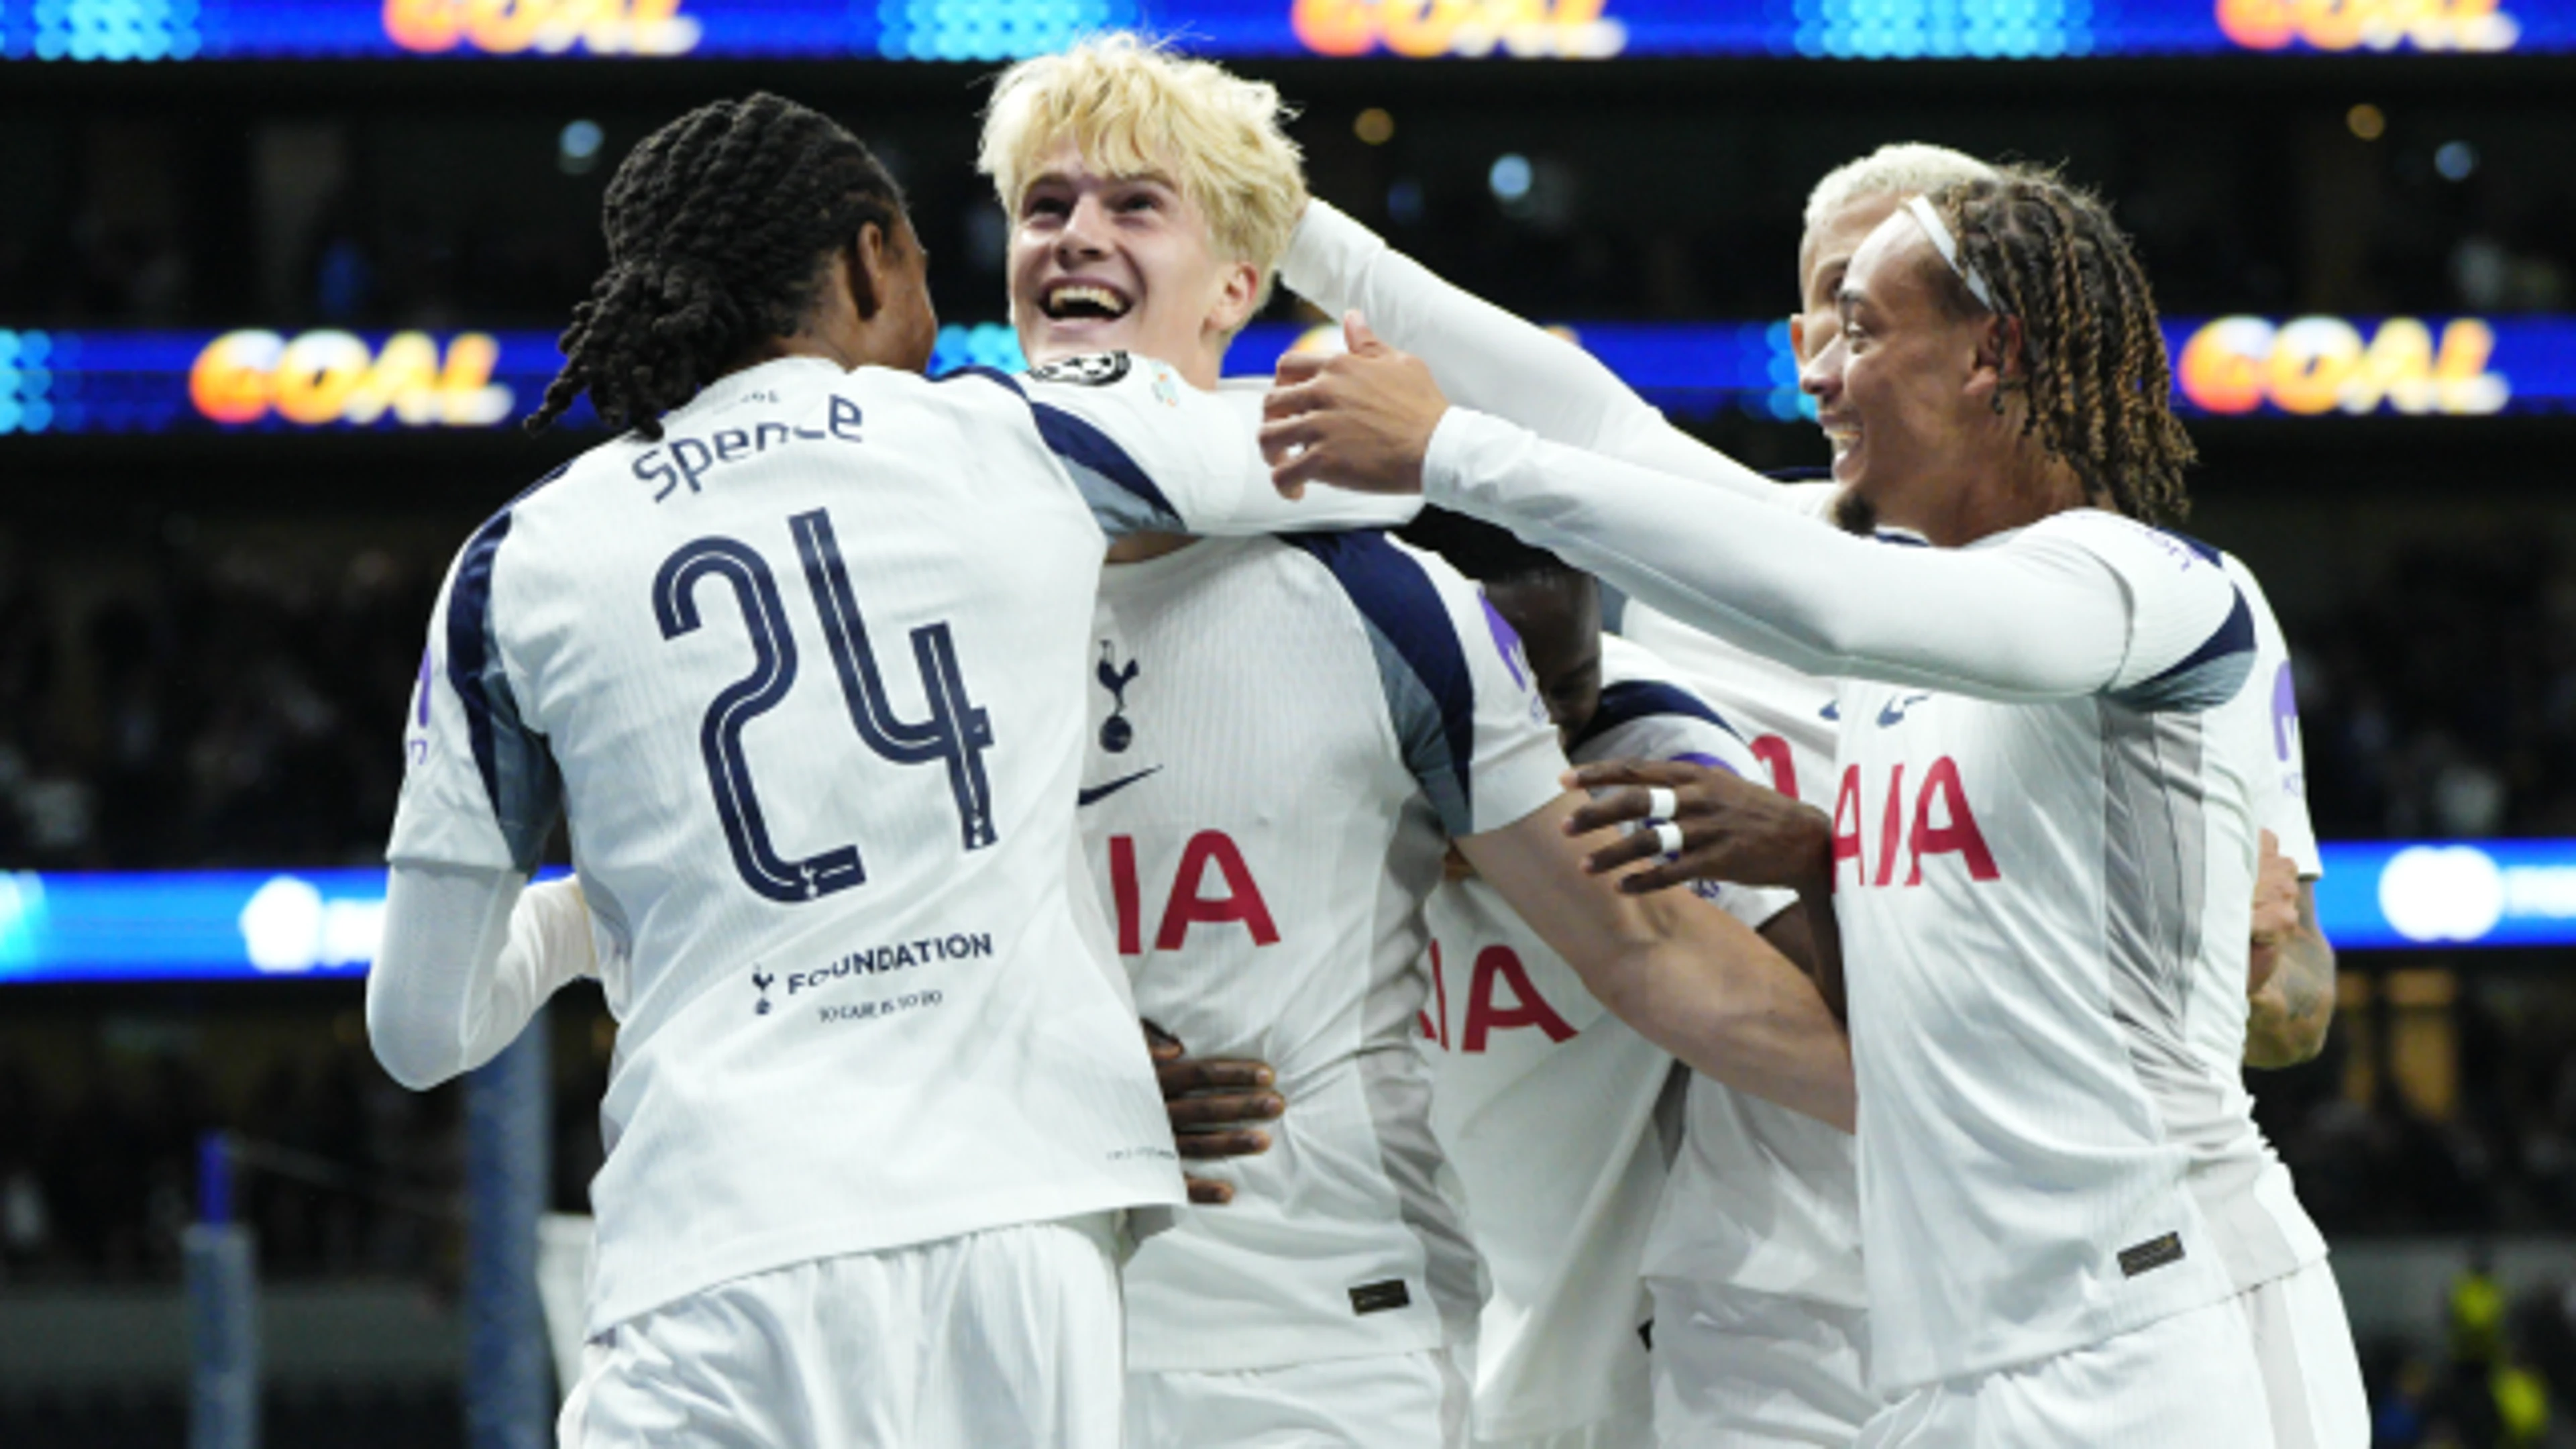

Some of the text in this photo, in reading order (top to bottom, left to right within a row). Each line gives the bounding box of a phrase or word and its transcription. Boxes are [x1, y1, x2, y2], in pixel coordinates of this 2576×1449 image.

[189, 329, 513, 426] GOAL
[2178, 315, 2510, 415] GOAL
[652, 507, 998, 904] 24
[788, 933, 993, 995] FOUNDATION
